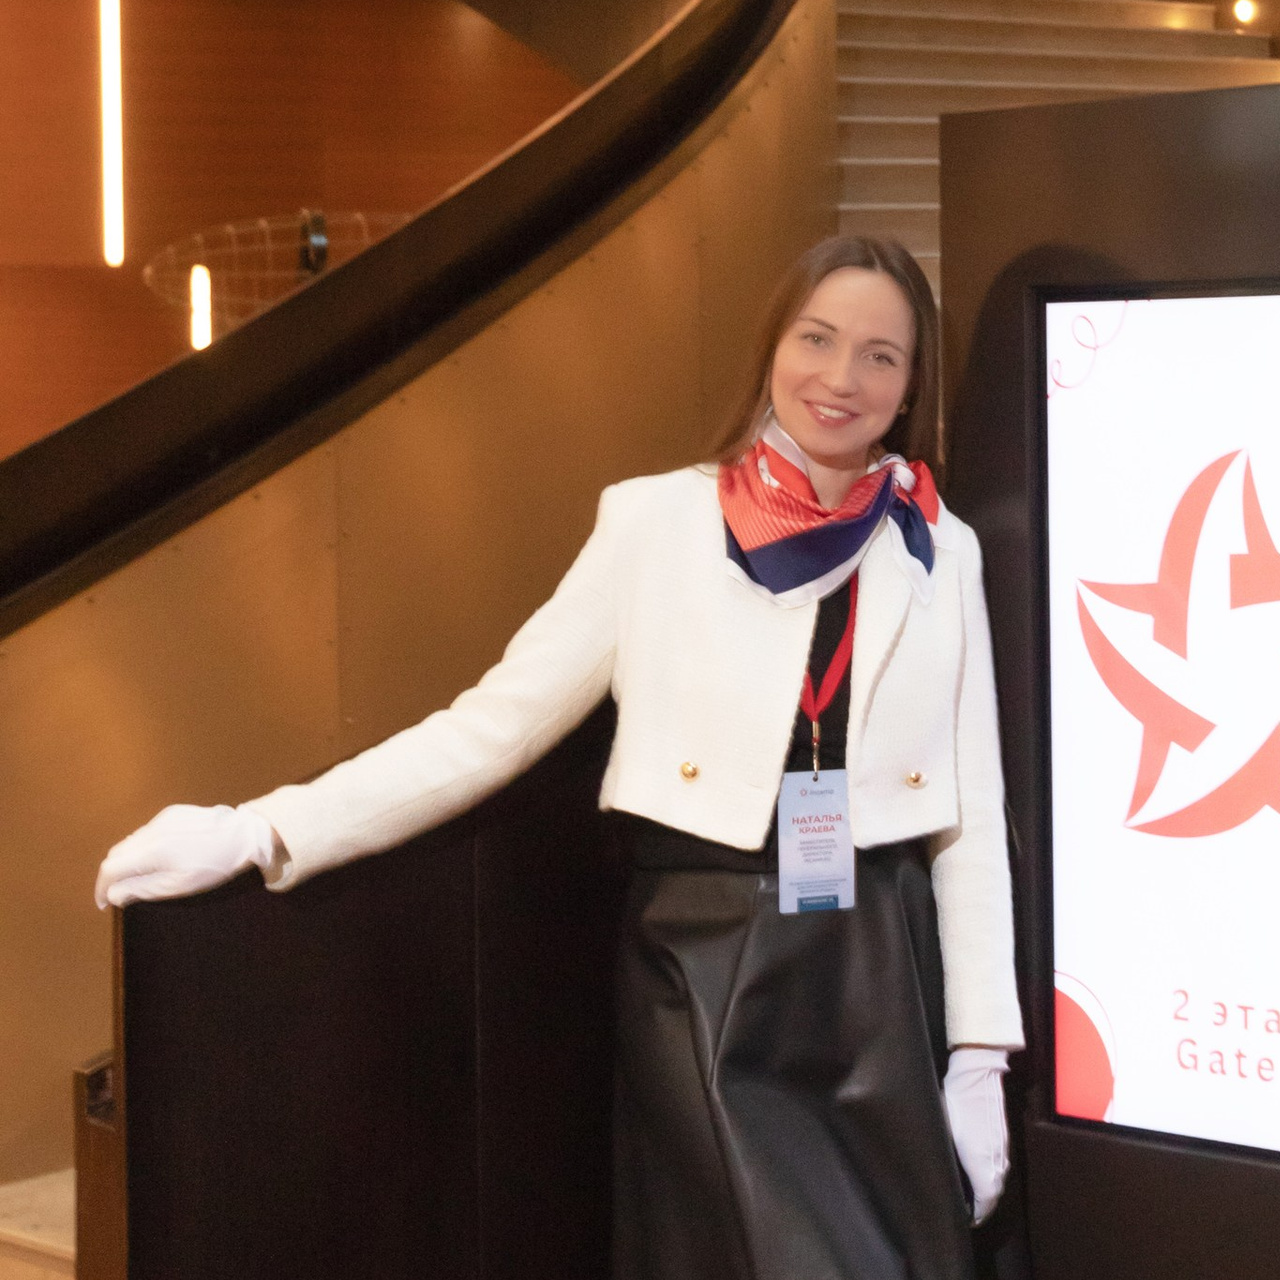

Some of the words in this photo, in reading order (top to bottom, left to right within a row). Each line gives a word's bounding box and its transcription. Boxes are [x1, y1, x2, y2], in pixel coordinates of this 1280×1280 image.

[792, 813, 842, 825] НАТАЛЬЯ
[798, 824, 836, 835] КРАЕВА
[1173, 989, 1190, 1022] 2
[1176, 1038, 1276, 1082] Gate
